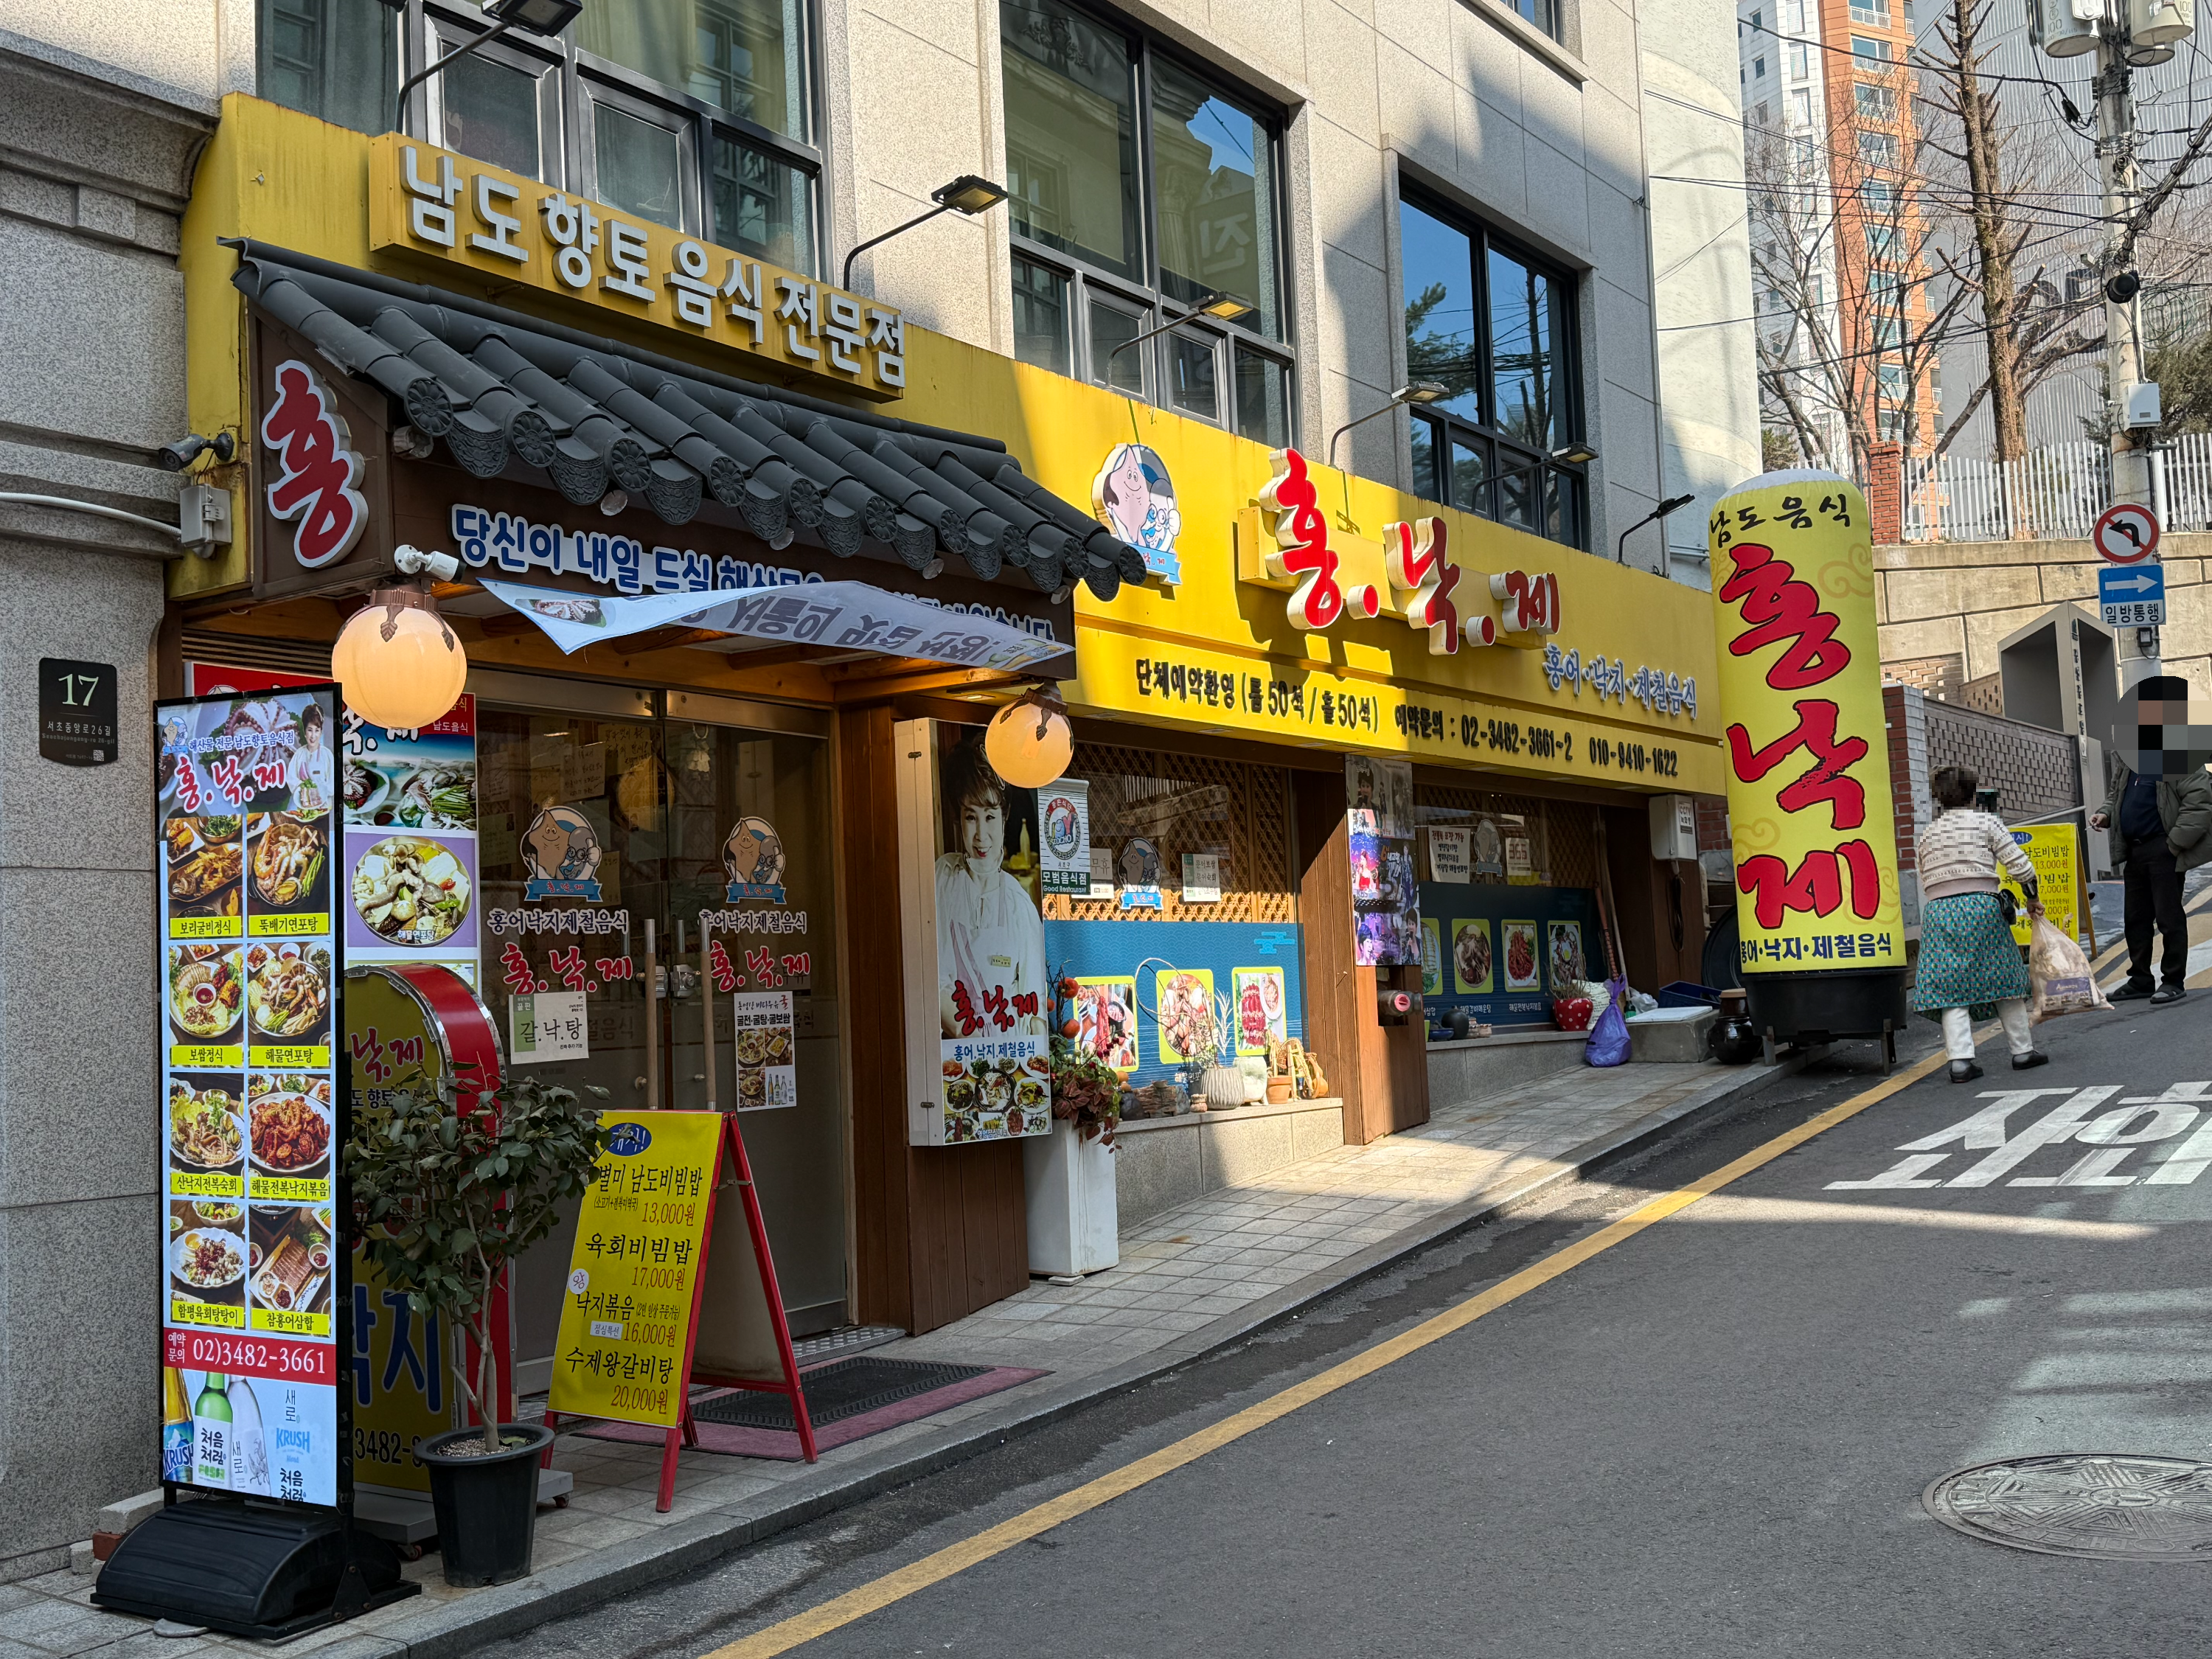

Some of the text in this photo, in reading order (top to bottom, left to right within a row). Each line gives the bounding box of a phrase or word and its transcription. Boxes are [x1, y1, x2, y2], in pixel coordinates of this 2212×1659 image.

[400, 145, 905, 389] 남도 향토 음식 전문점
[262, 360, 363, 568] 홍
[455, 507, 562, 572] 당신이
[576, 535, 640, 589] 내일
[2105, 603, 2160, 625] 일방통행
[58, 673, 99, 706] 17
[1135, 658, 1235, 710] 단체예약환영
[47, 720, 111, 737] 서초중앙로26길
[1394, 703, 1444, 741] 예약문의
[1589, 737, 1678, 776] 010-9410-1622
[189, 737, 213, 752] 해산물
[1042, 871, 1087, 886] 모범음식점
[1043, 885, 1059, 893] Good
[179, 920, 232, 936] 보리굴비정식
[259, 917, 319, 933] 뚝배기연포탕
[487, 908, 629, 935] 홍어낙지제철음식
[397, 929, 434, 941] 해물연포탕
[520, 1017, 583, 1043] 갈.낙.탕
[189, 1048, 223, 1062] 보쌈정식
[265, 1048, 314, 1063] 해물연포탕
[176, 1175, 237, 1192] 산낙지전복숙회
[251, 1180, 328, 1197] 해물전복낙지볶음
[599, 1163, 703, 1197] 별미 남도비빔밥
[641, 1202, 696, 1227] 13,000원
[585, 1232, 693, 1265] 육회비빔밥
[631, 1266, 686, 1291] 17,000원
[177, 1304, 238, 1324] 함평육회탕탕이
[576, 1290, 635, 1321] 낙지볶음
[265, 1312, 314, 1331] 참홍어삼합
[594, 1324, 620, 1338] 점심특선
[167, 1332, 187, 1347] 예약
[623, 1321, 677, 1348] 16,000원
[167, 1349, 185, 1364] 문의
[193, 1338, 325, 1374] 02)3482-3661
[565, 1346, 674, 1385] 수제왕갈비탕
[611, 1384, 669, 1416] 20,000원
[201, 1427, 224, 1449] 처음
[276, 1427, 310, 1453] KRUSH
[201, 1445, 224, 1466] 처럼
[279, 1467, 304, 1487] 처음
